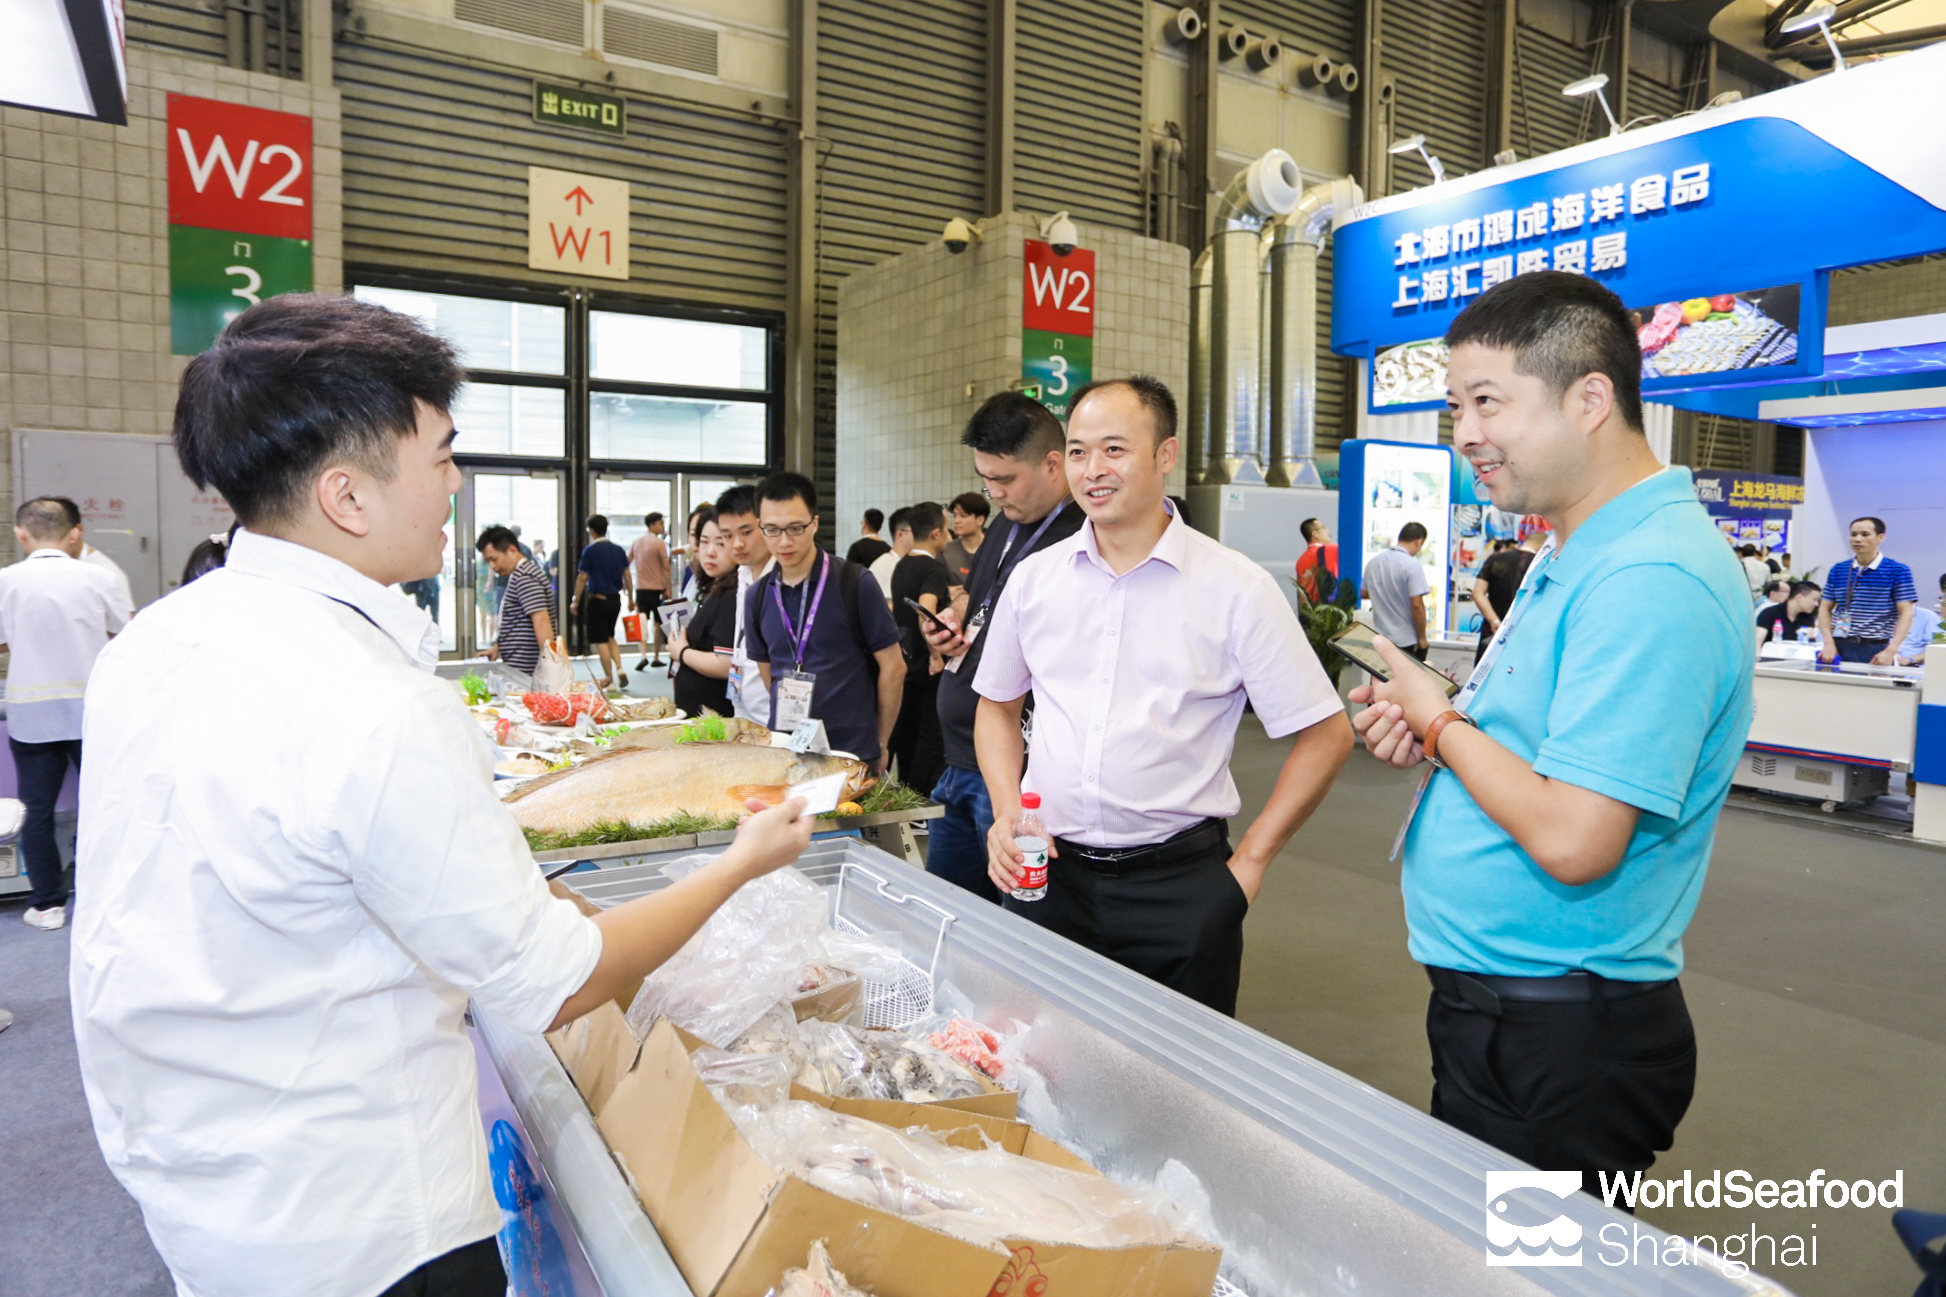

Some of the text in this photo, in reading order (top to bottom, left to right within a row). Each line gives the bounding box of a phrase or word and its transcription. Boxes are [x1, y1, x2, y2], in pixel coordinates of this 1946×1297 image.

[542, 92, 618, 126] 出 EXIT 口
[176, 127, 304, 207] W2
[1394, 163, 1709, 266] 北海市鸿成海洋食品
[549, 222, 611, 266] W1
[224, 265, 262, 305] 3
[1029, 262, 1091, 313] W2
[1047, 355, 1068, 396] 3
